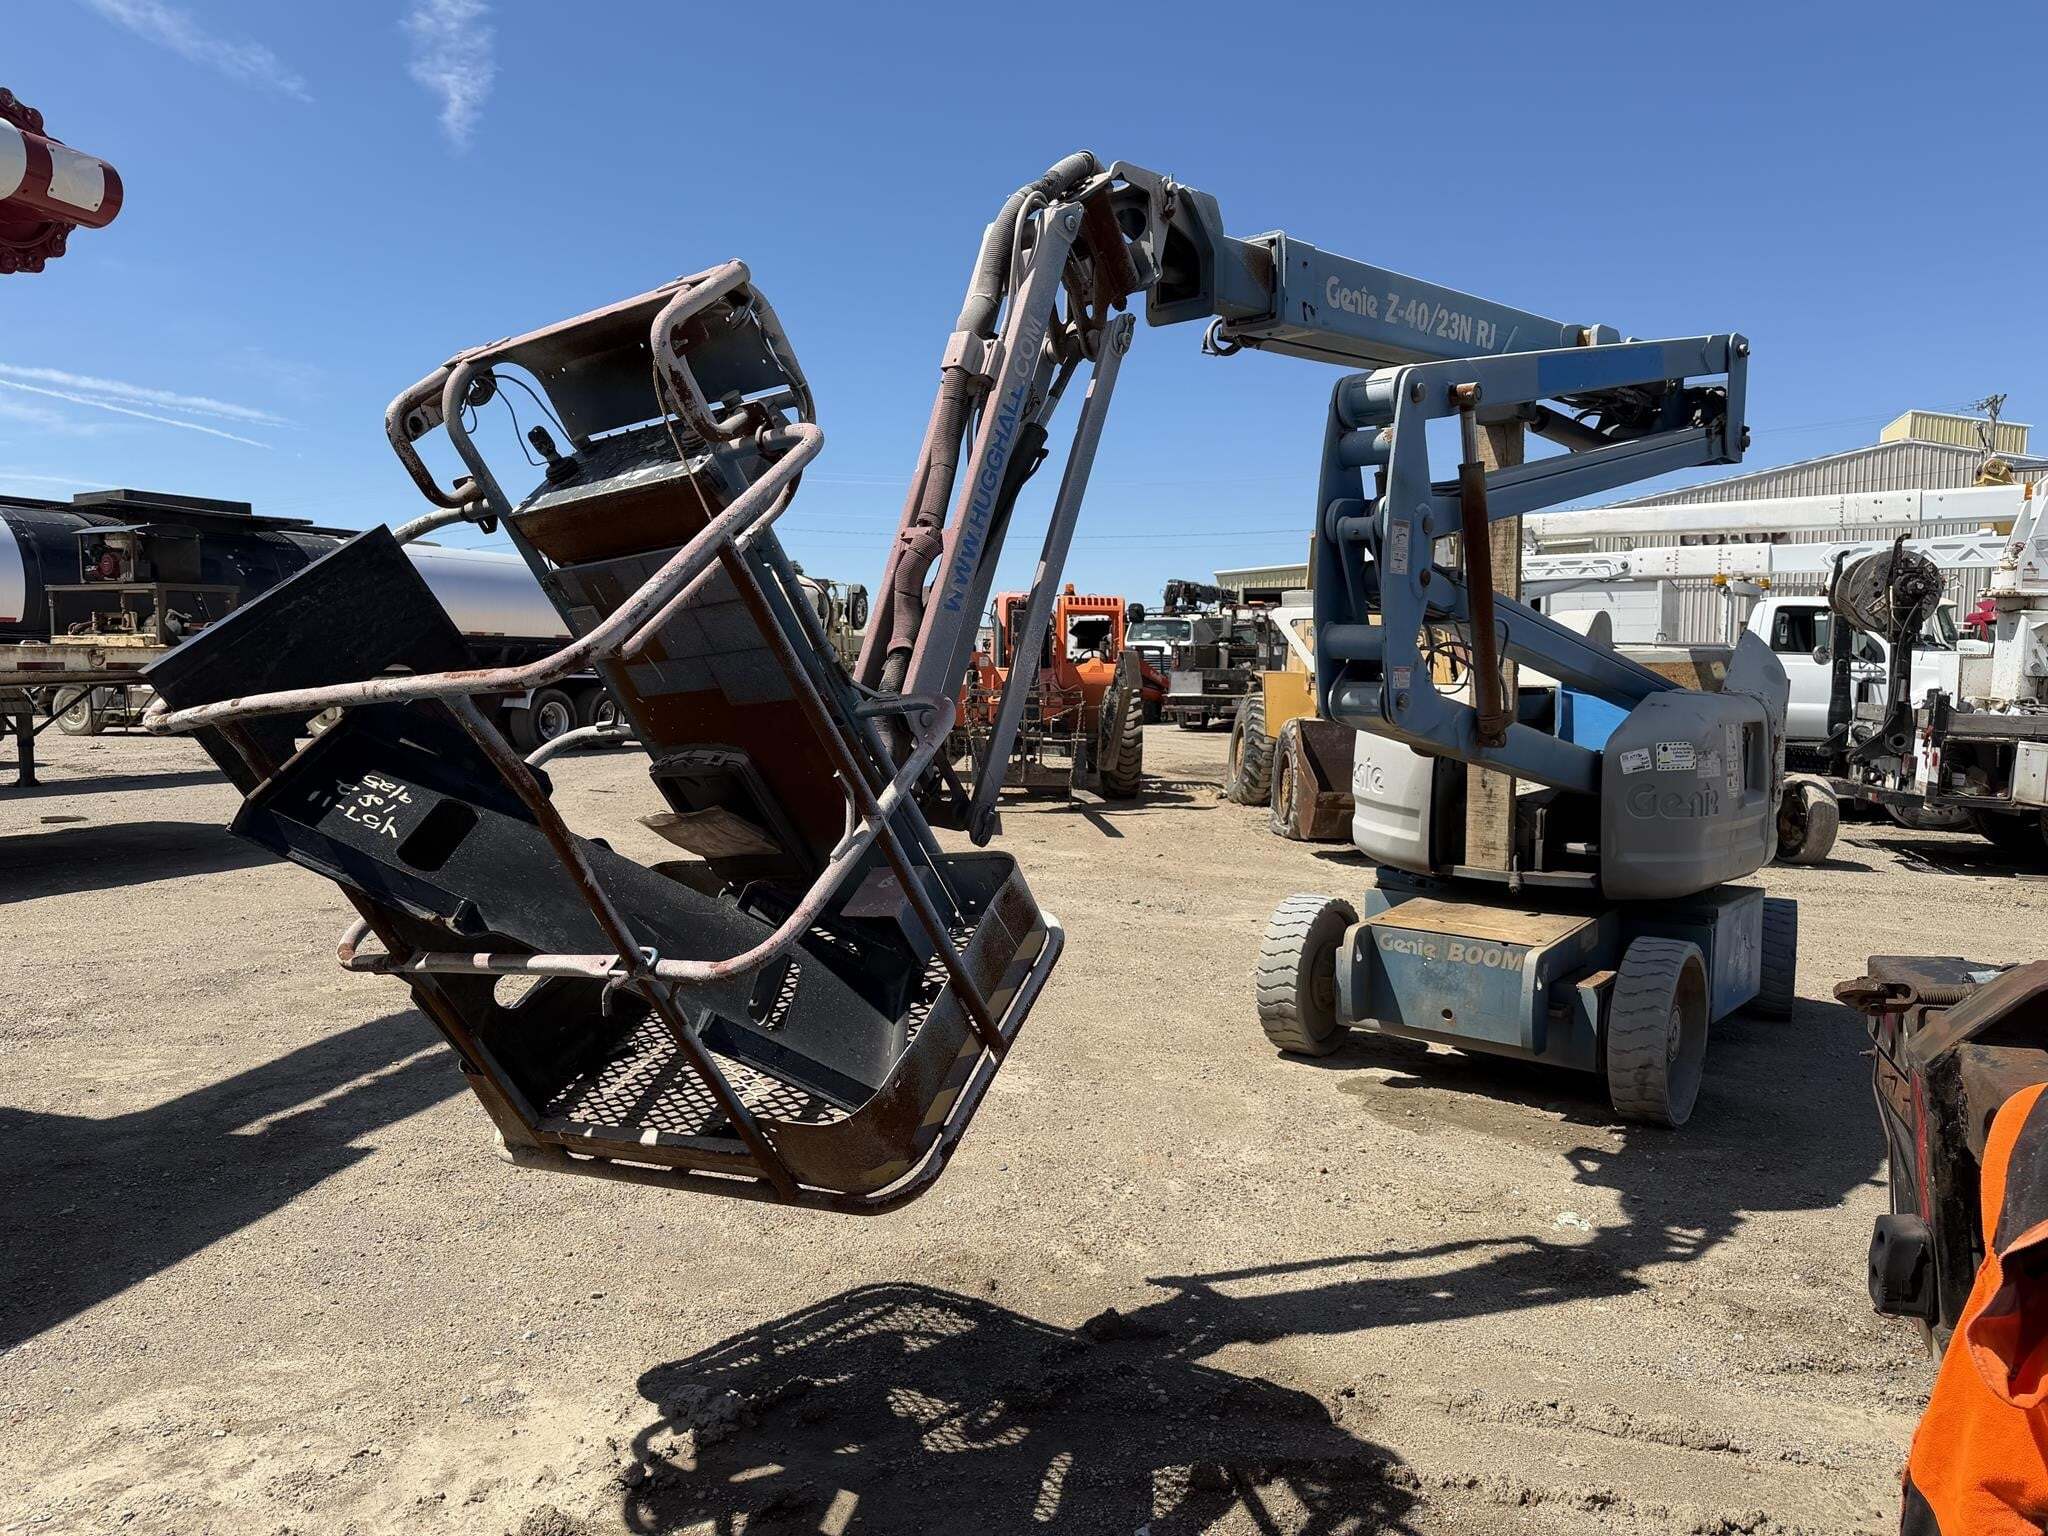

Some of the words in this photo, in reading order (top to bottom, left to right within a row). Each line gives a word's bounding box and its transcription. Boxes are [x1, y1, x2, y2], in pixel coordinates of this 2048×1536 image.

[1325, 274, 1378, 319] Genie
[1384, 292, 1473, 342] Z-40/23N
[1476, 319, 1497, 350] RJ
[943, 315, 1044, 612] WWW.HUGGHALL.COM
[1378, 932, 1437, 959] Genie
[1447, 942, 1524, 972] BOOM
